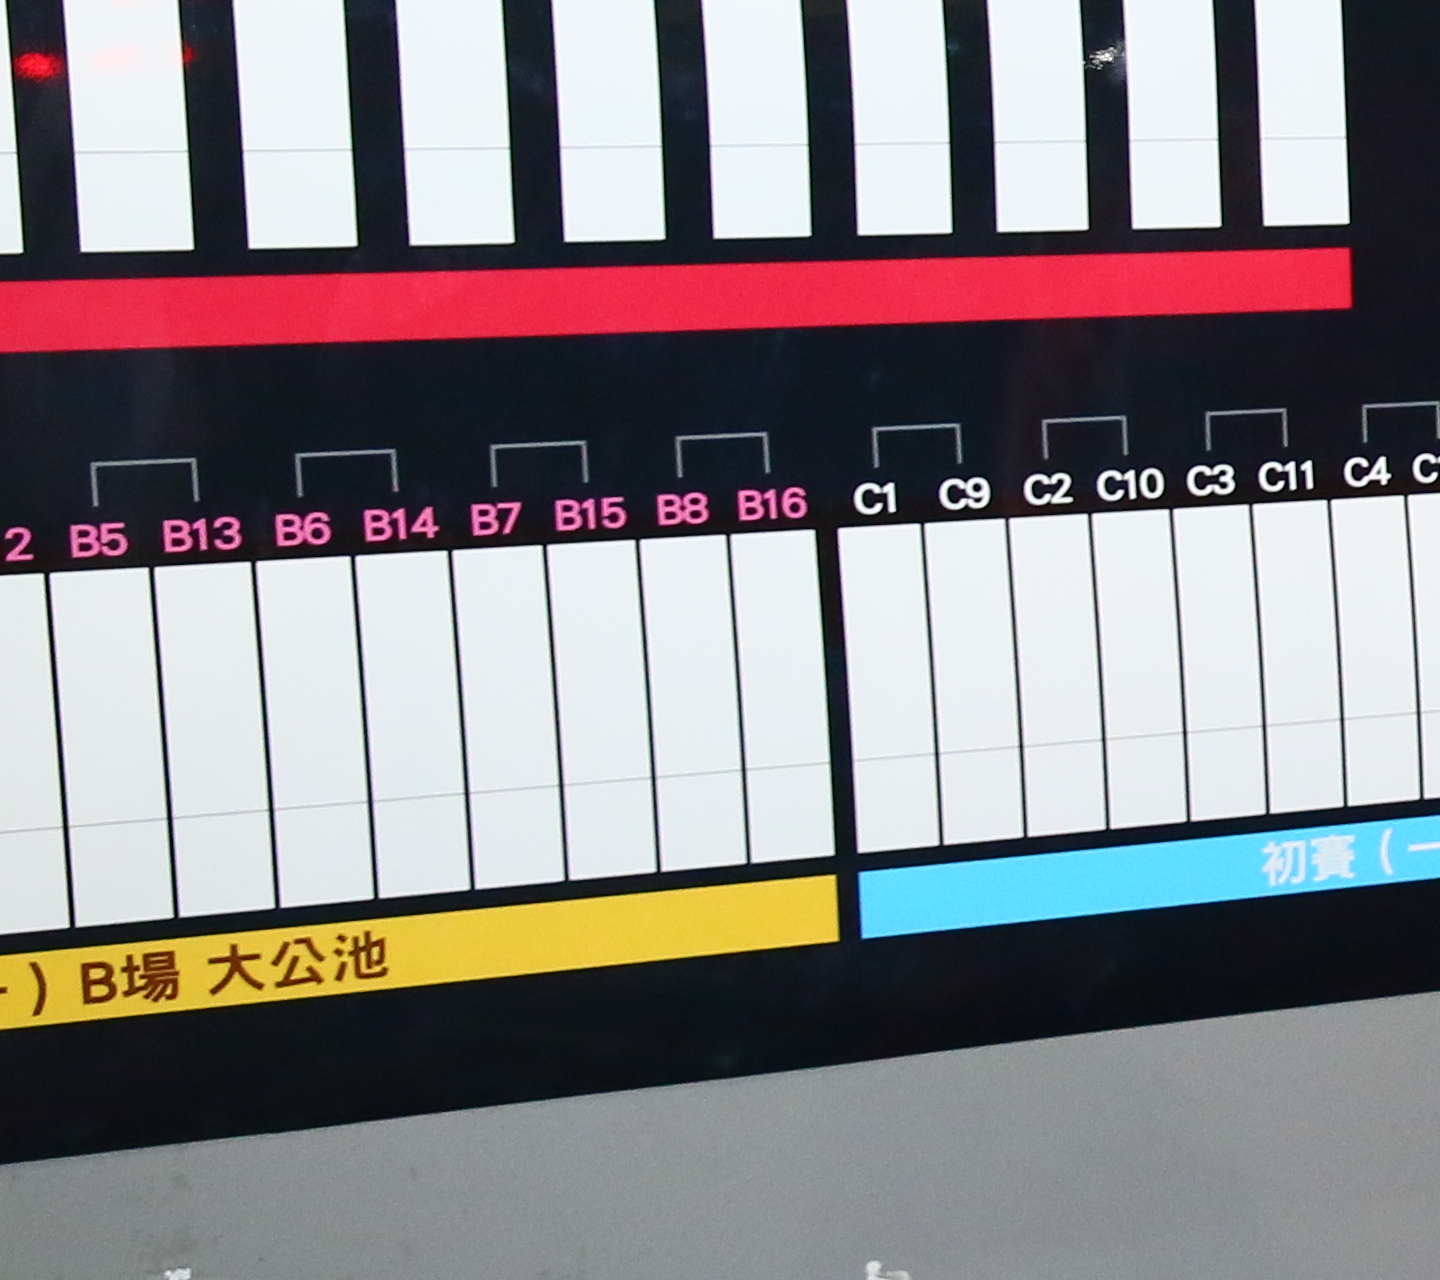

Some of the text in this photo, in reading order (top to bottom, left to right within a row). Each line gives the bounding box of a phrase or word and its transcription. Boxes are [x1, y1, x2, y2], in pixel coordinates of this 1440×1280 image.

[853, 482, 897, 515] C1
[938, 476, 991, 510] C9
[1023, 472, 1074, 506] C2
[1096, 467, 1165, 502] C10
[1186, 464, 1236, 497] C3
[1258, 460, 1314, 492] C11
[1343, 456, 1392, 488] C4
[69, 522, 129, 559] B5
[162, 516, 242, 553] B13
[274, 511, 332, 547] B6
[363, 506, 440, 542] B14
[470, 501, 522, 537] B7
[554, 496, 627, 532] B15
[656, 492, 709, 526] B8
[737, 486, 808, 521] B16
[206, 929, 389, 998] 大公池
